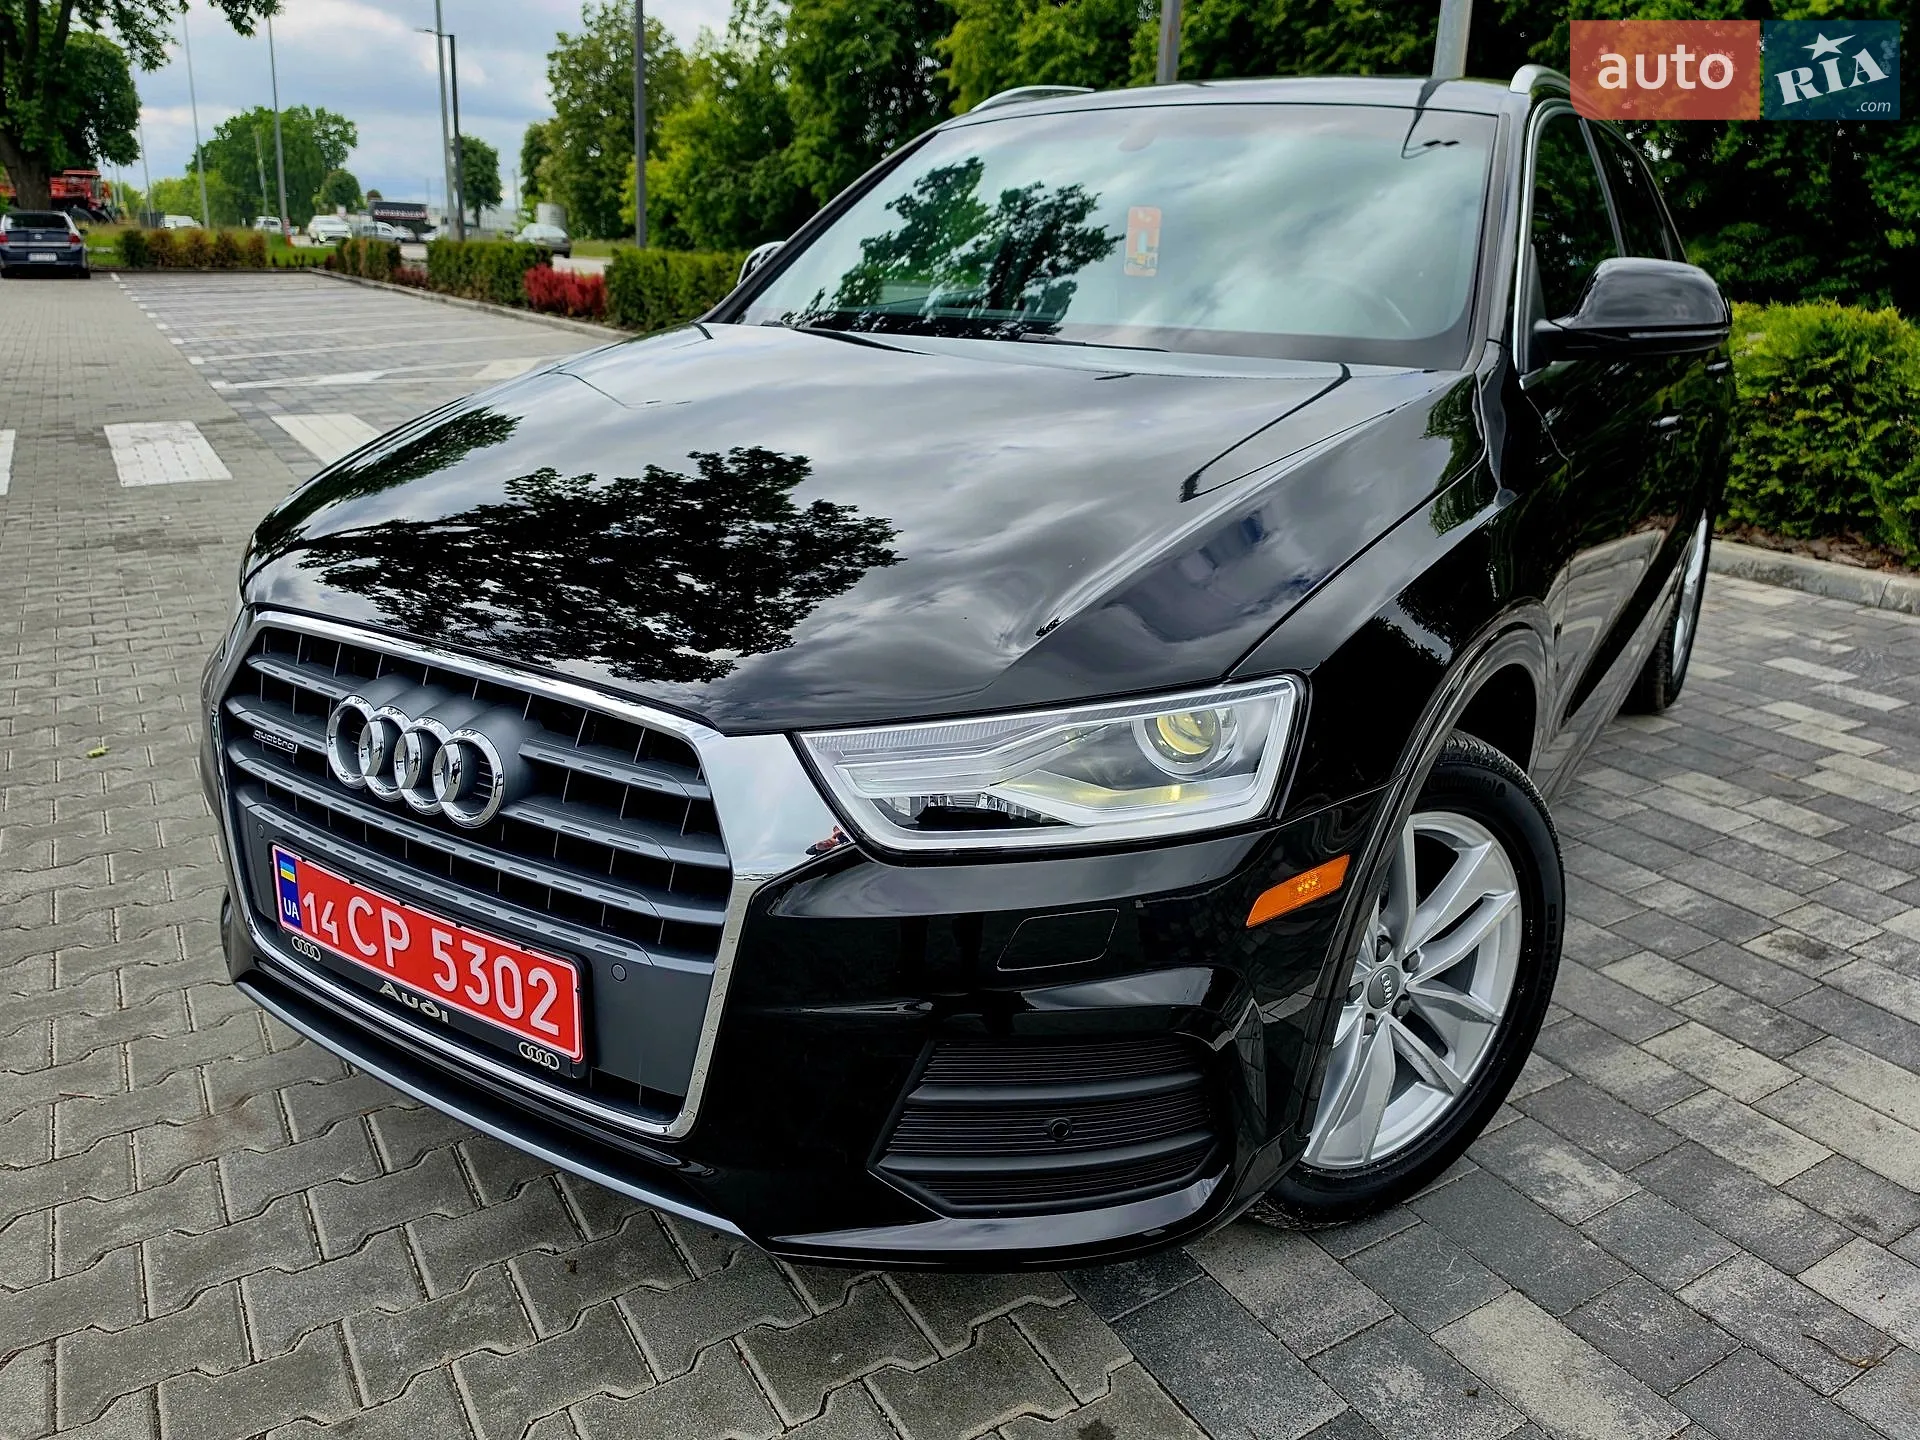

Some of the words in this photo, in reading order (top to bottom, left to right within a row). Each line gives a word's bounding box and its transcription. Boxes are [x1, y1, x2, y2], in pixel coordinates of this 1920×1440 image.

[254, 729, 295, 750] quattro
[283, 897, 300, 921] UA
[302, 891, 340, 946] 14
[347, 896, 411, 968] CP
[431, 927, 560, 1037] 5302
